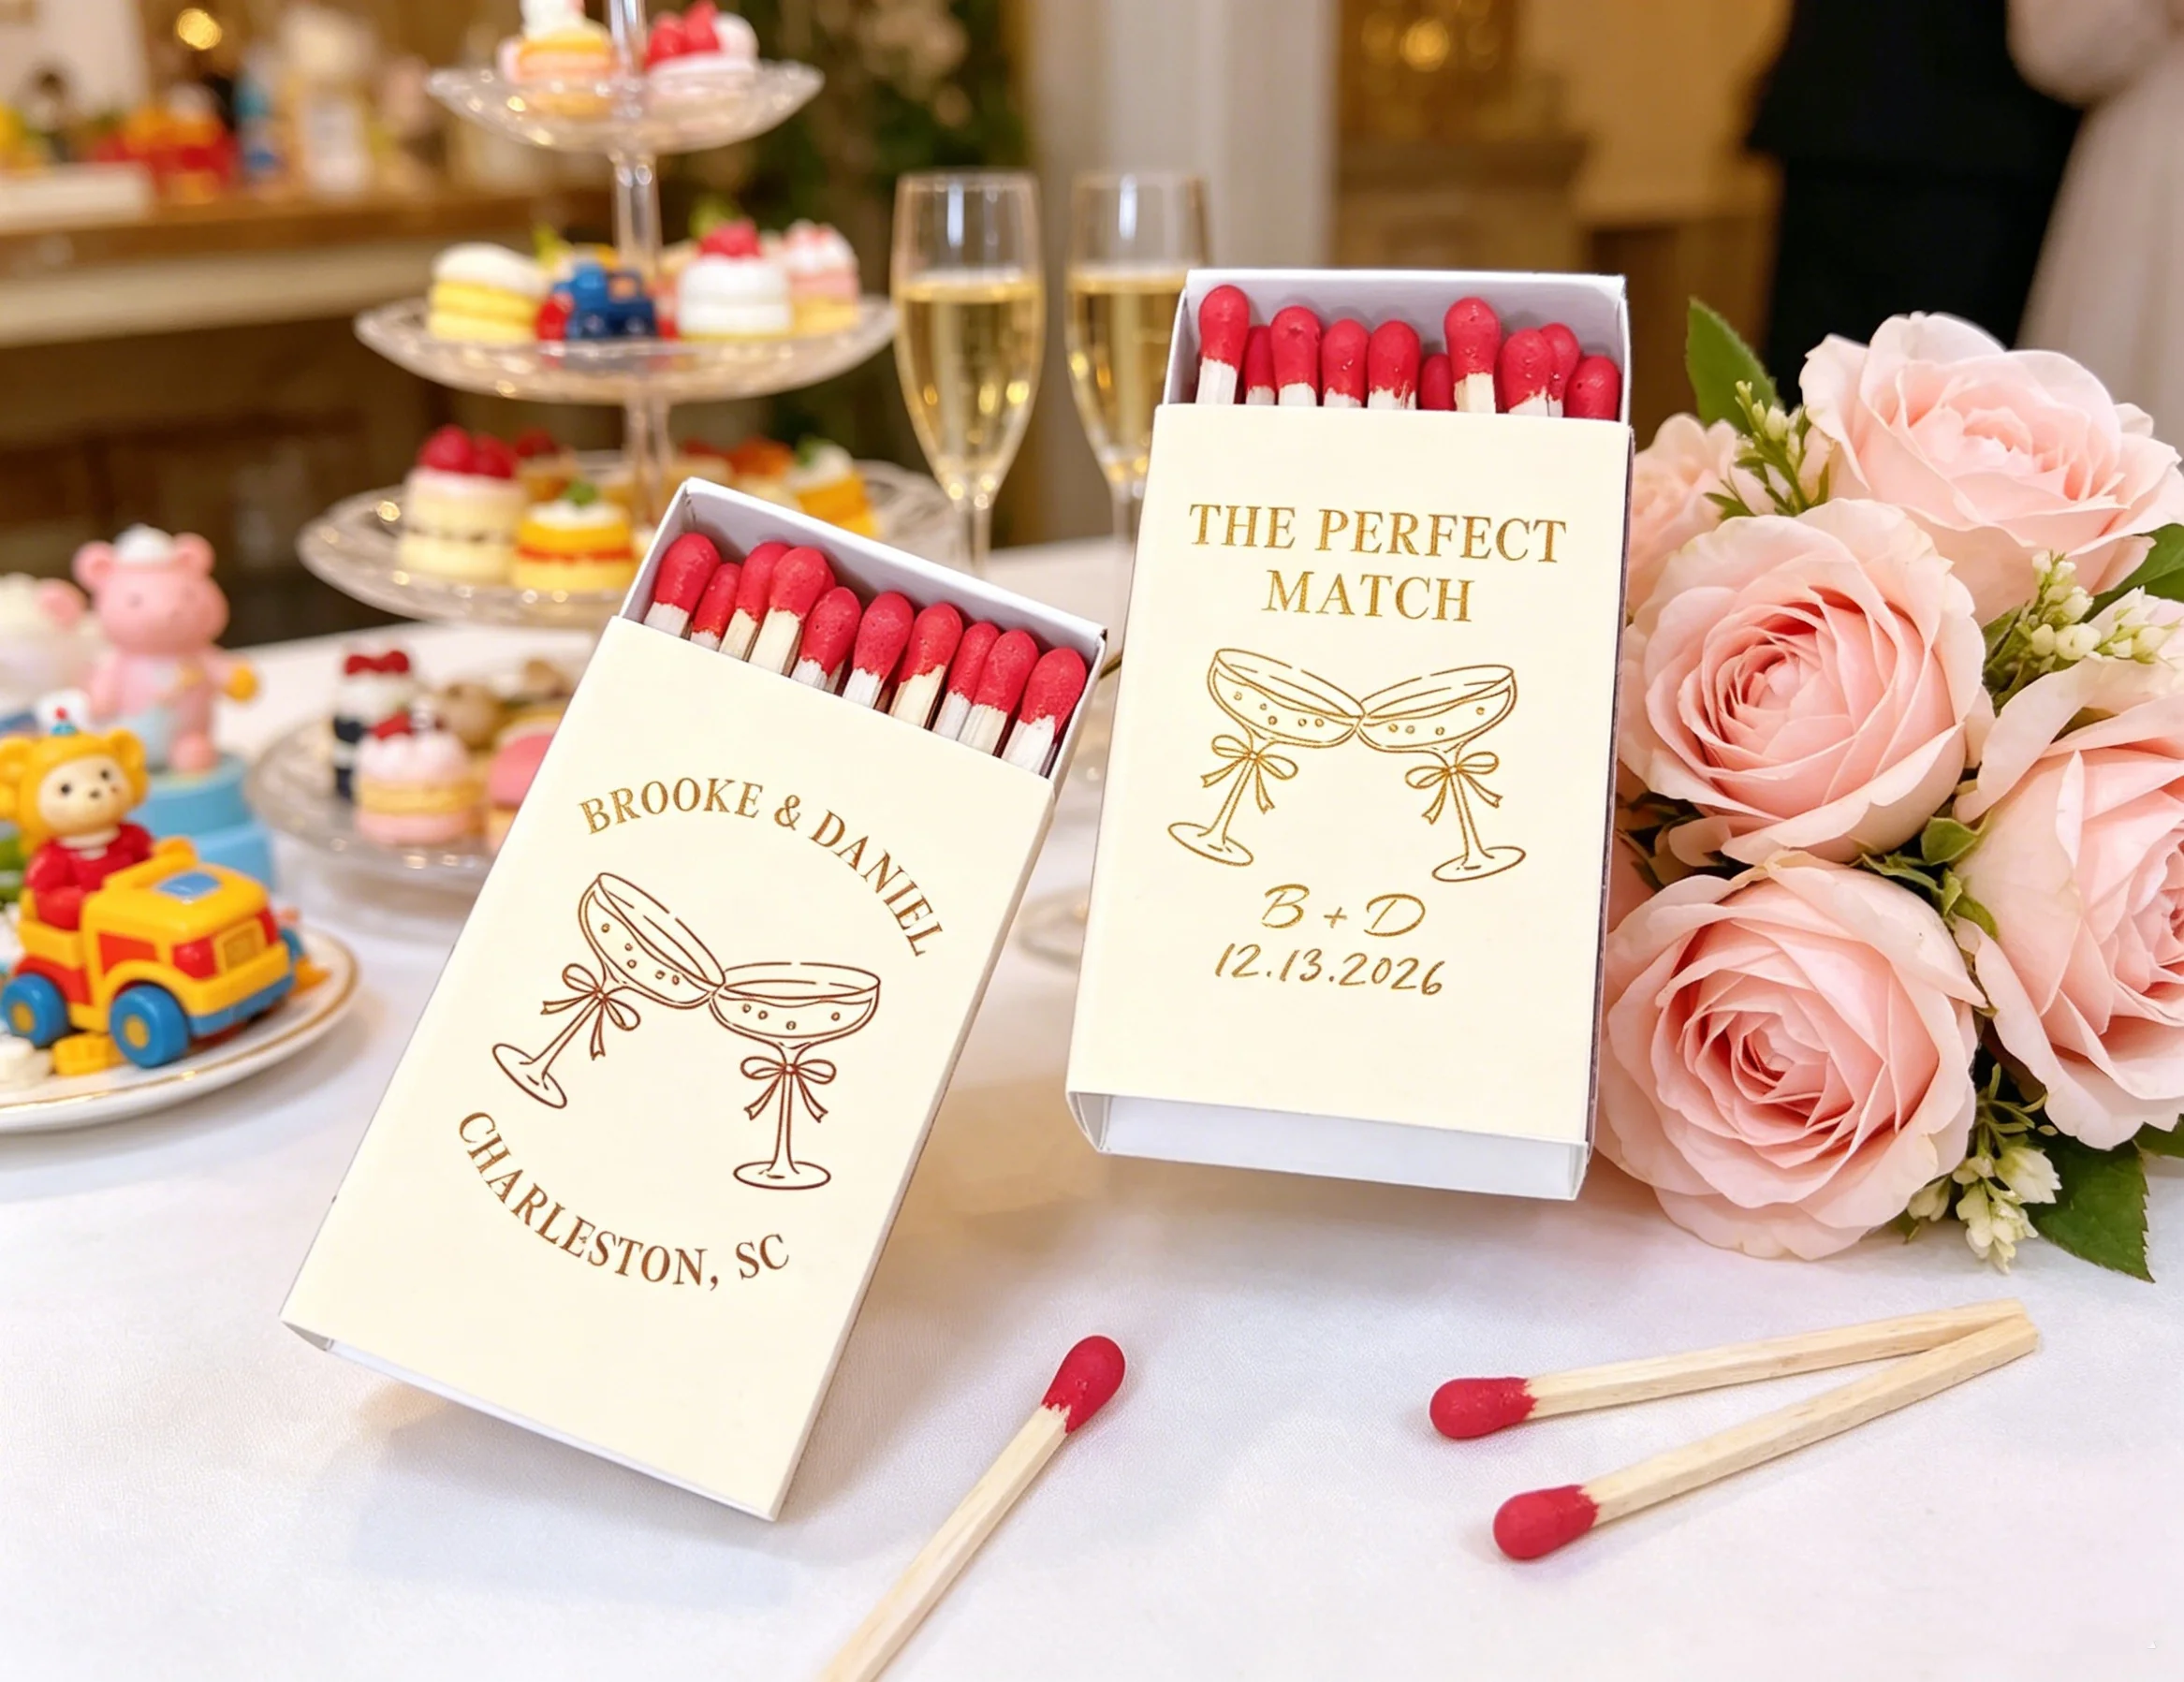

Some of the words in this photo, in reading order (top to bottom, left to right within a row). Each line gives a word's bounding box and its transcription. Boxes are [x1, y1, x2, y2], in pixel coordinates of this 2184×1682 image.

[1189, 504, 1296, 549] THE
[1314, 508, 1567, 563] PERFECT
[1261, 569, 1474, 622] MATCH
[578, 777, 764, 835] BROOKE
[773, 794, 801, 831] &
[809, 810, 944, 958] DANIEL
[1261, 883, 1311, 929] B
[1323, 906, 1348, 929] +
[1363, 892, 1427, 938] D
[1214, 943, 1446, 997] 12.13.2026
[458, 1111, 720, 1291] CHARLESTON,
[734, 1233, 790, 1280] SC
